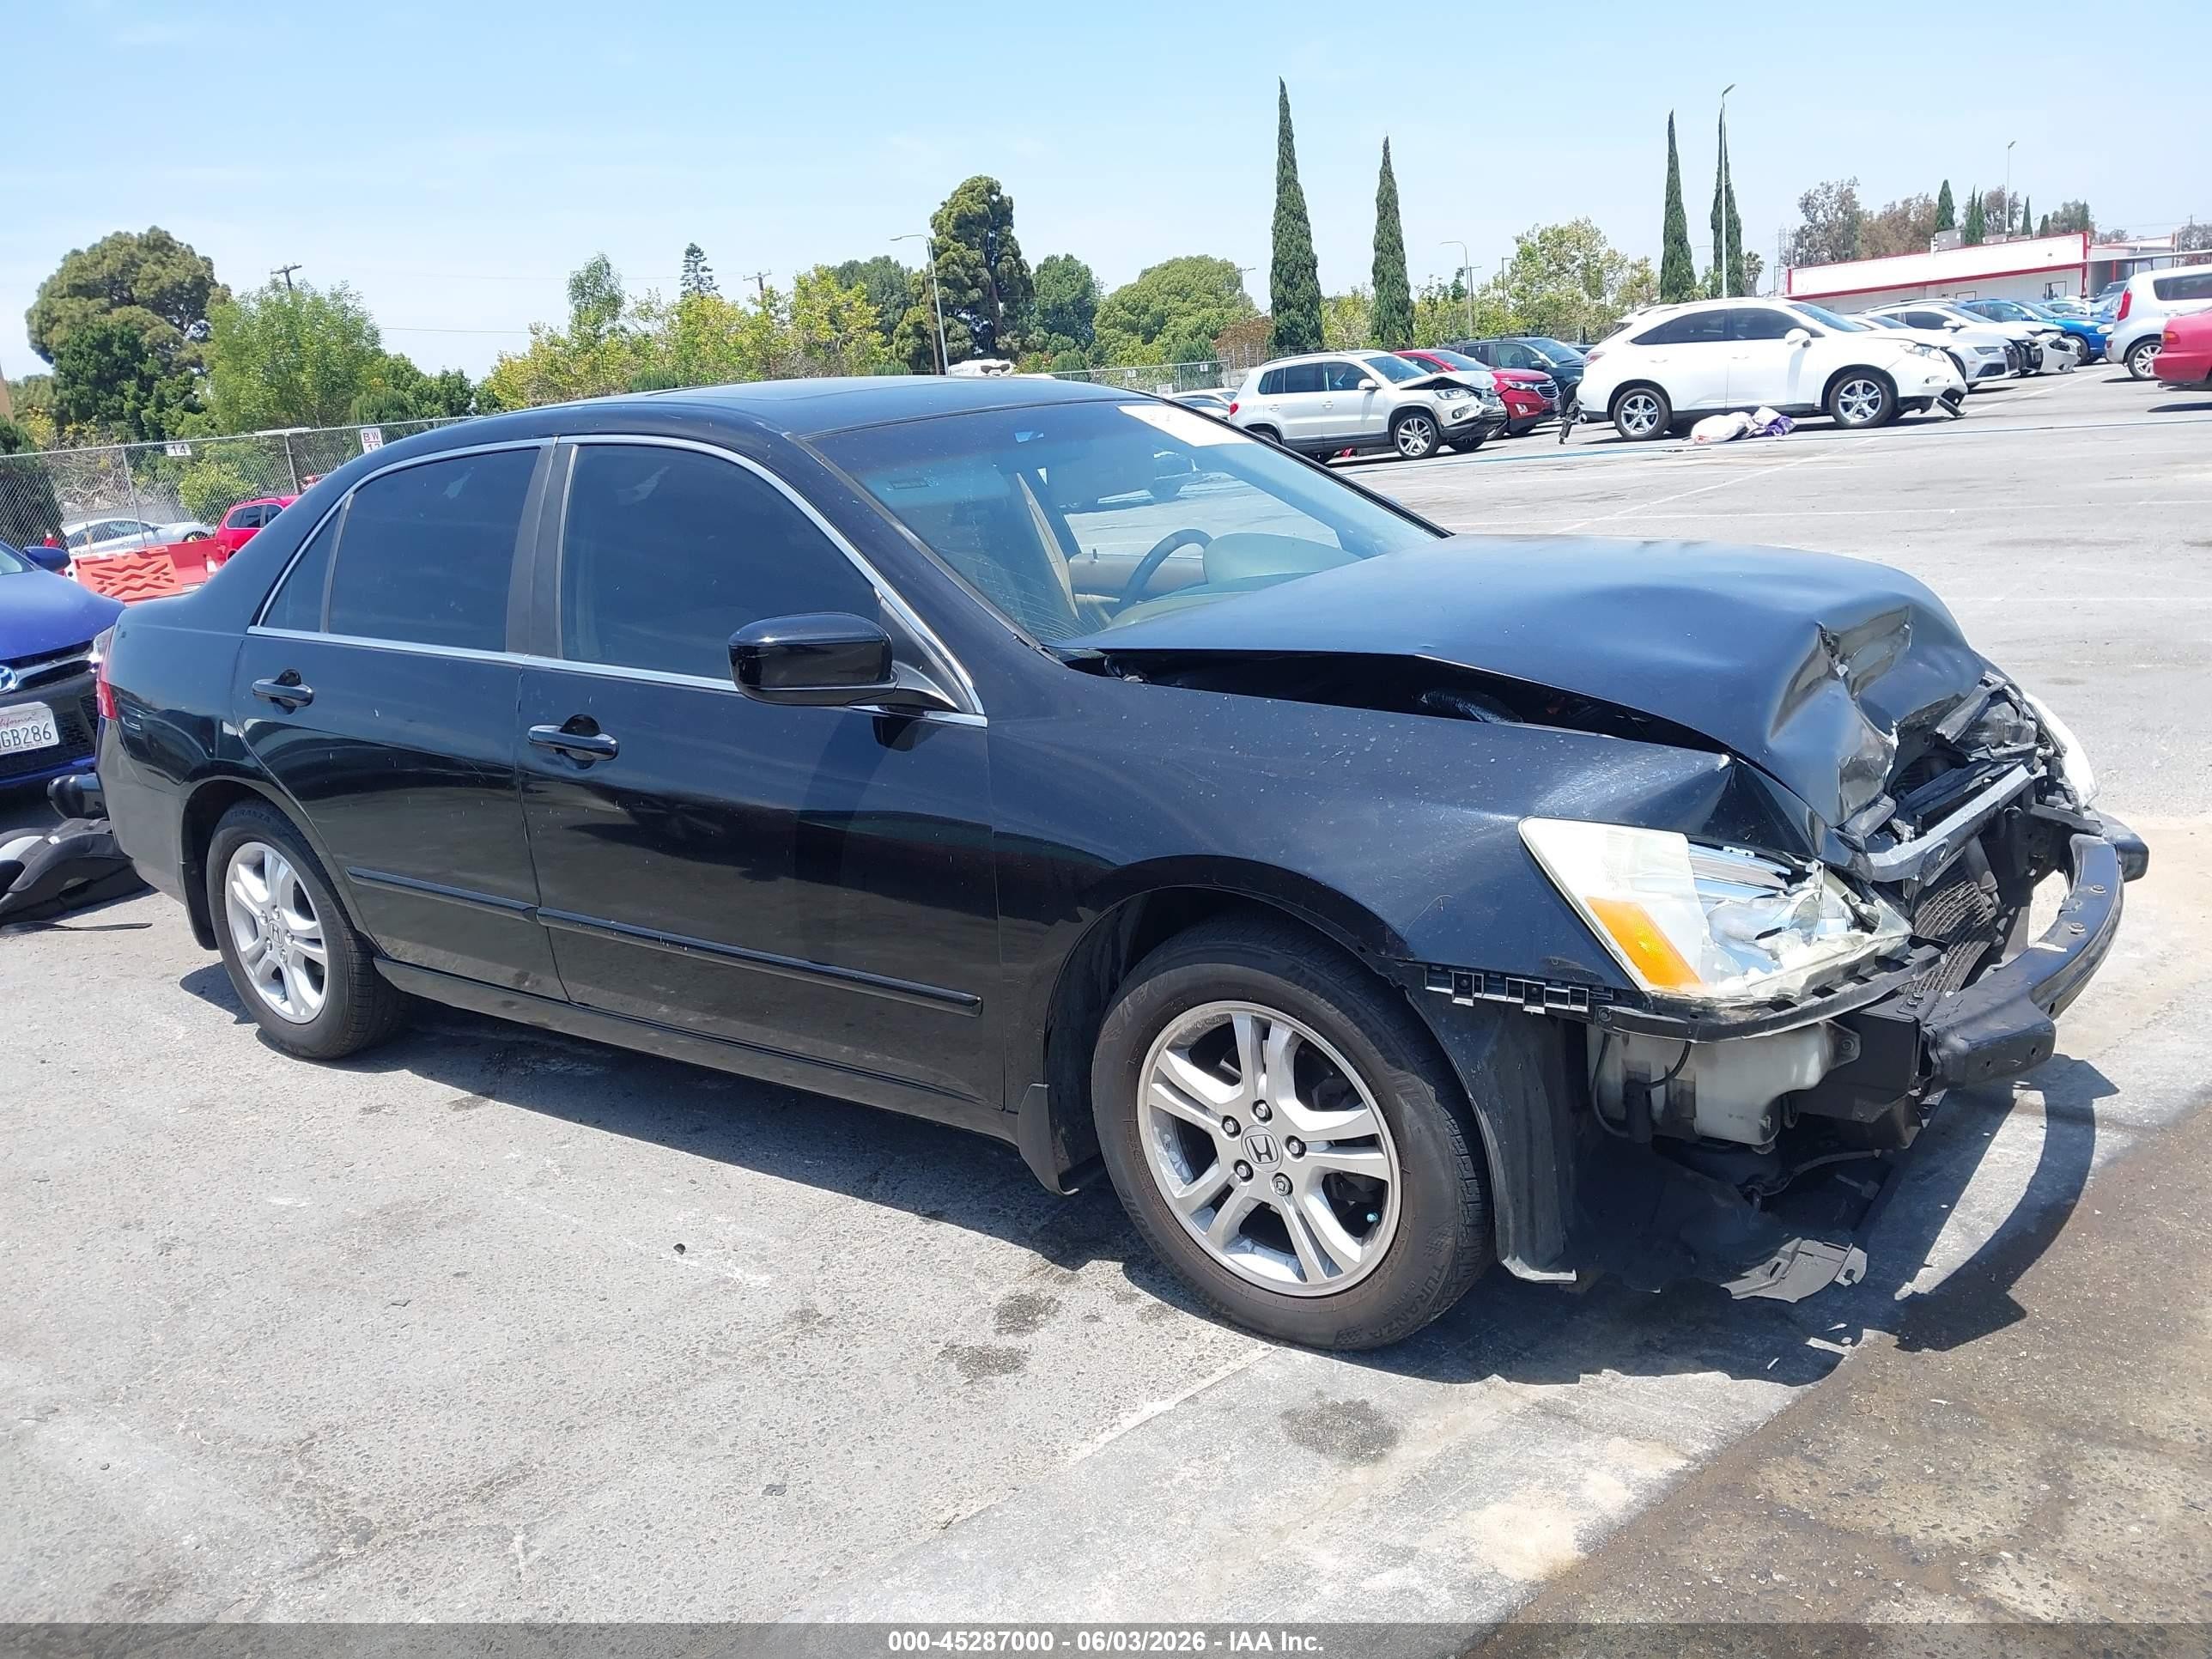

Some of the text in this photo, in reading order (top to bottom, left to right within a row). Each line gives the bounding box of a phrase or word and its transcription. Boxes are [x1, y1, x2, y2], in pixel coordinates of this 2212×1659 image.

[363, 432, 379, 441] BW
[171, 445, 186, 454] 14
[0, 721, 52, 748] GB286
[1369, 1264, 1445, 1340] TURANZA
